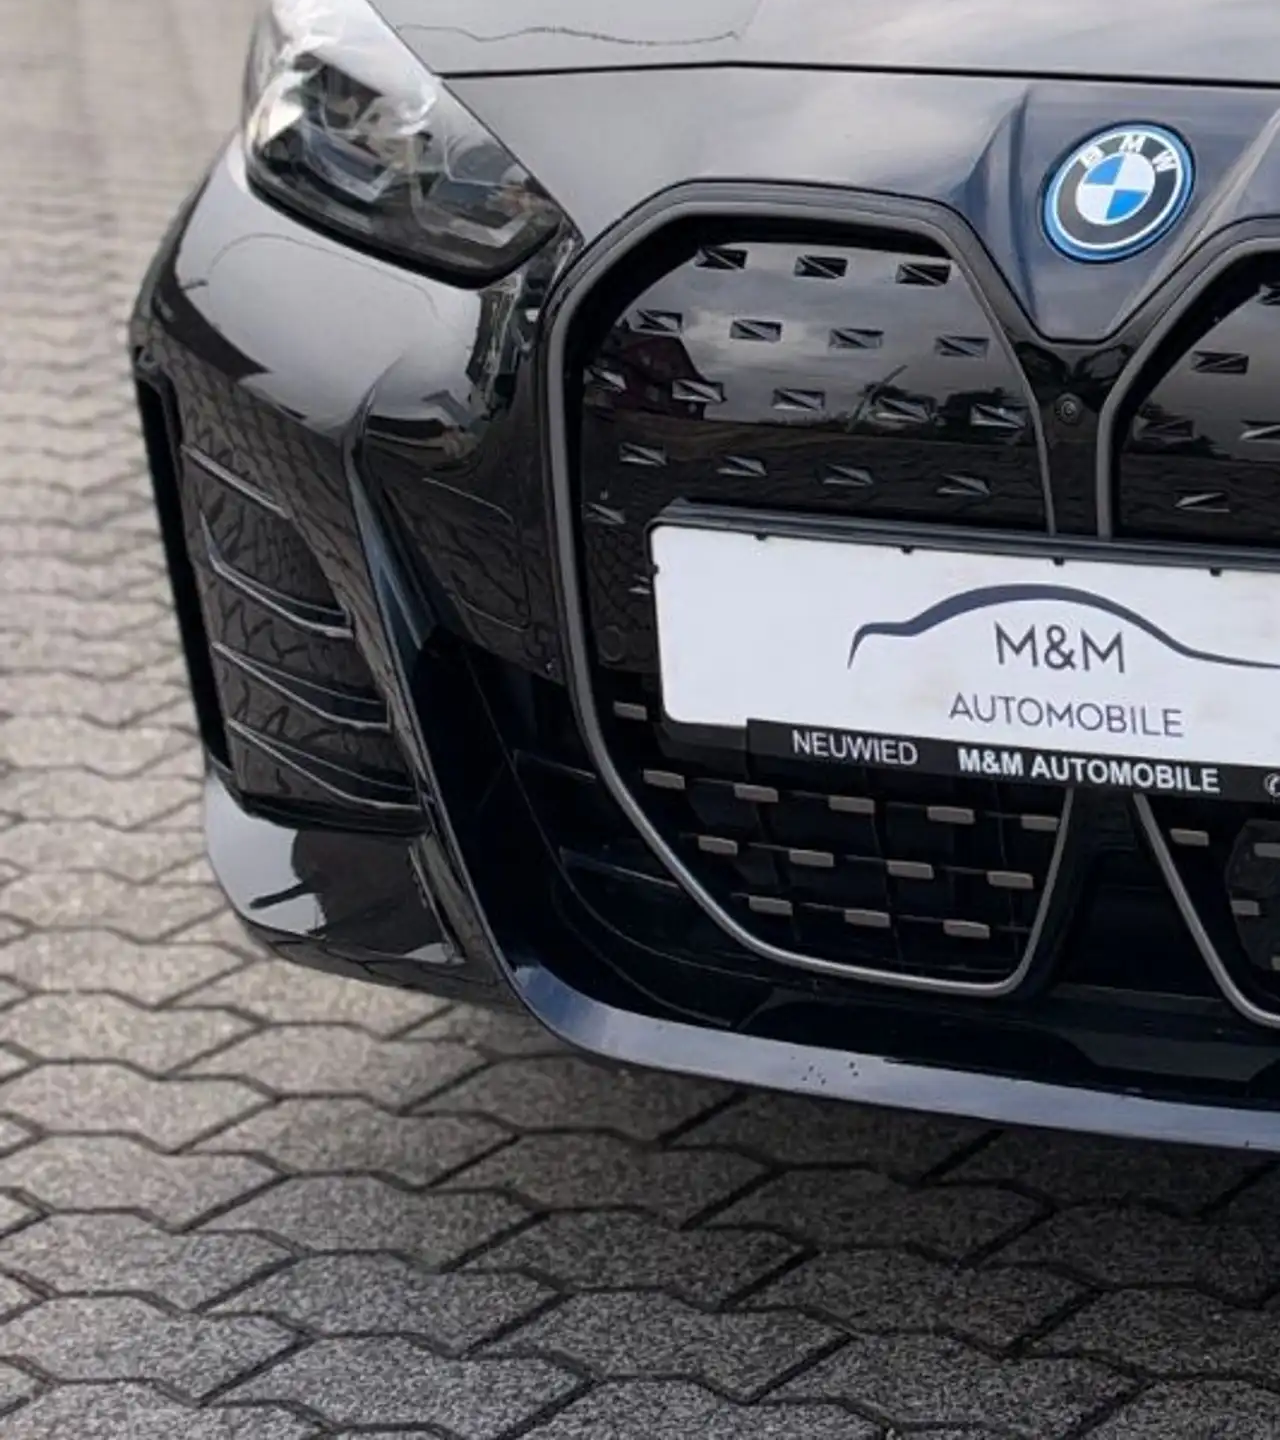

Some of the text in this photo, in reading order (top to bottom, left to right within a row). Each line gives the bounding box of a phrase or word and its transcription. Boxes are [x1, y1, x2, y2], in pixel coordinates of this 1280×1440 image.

[1078, 134, 1178, 173] BMW
[994, 620, 1126, 674] M&M
[949, 691, 1184, 738] AUTOMOBILE
[792, 729, 1221, 793] NEUWIED M&M AUTOMOBILE
